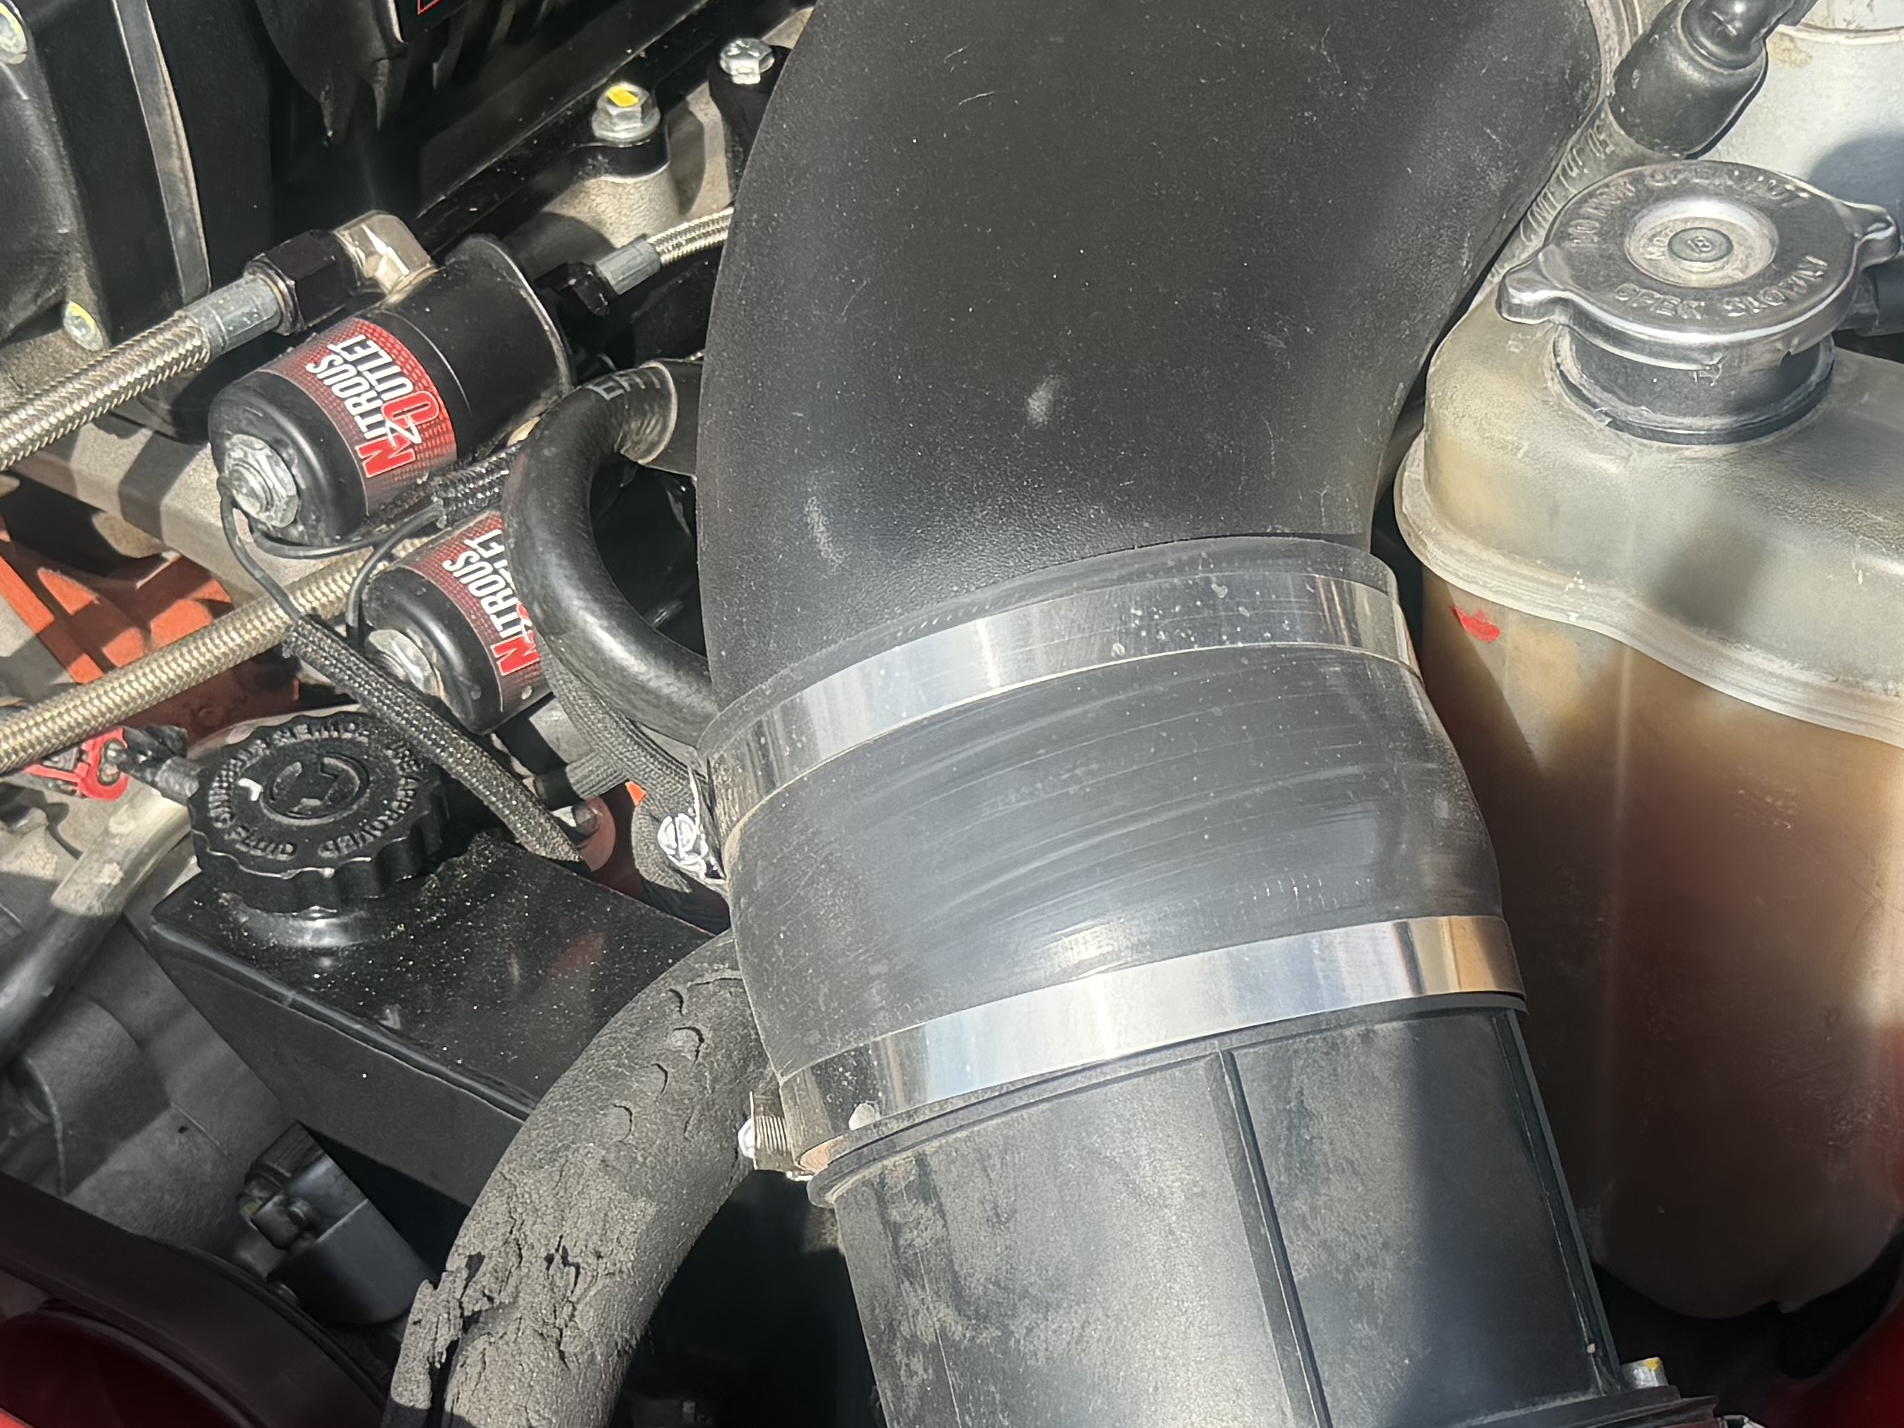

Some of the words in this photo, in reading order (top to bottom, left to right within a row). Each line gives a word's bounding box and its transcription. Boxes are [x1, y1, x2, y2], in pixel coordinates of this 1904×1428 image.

[305, 352, 417, 479] NITROUS
[327, 334, 440, 430] OUTLET
[442, 549, 542, 677] NITROUS
